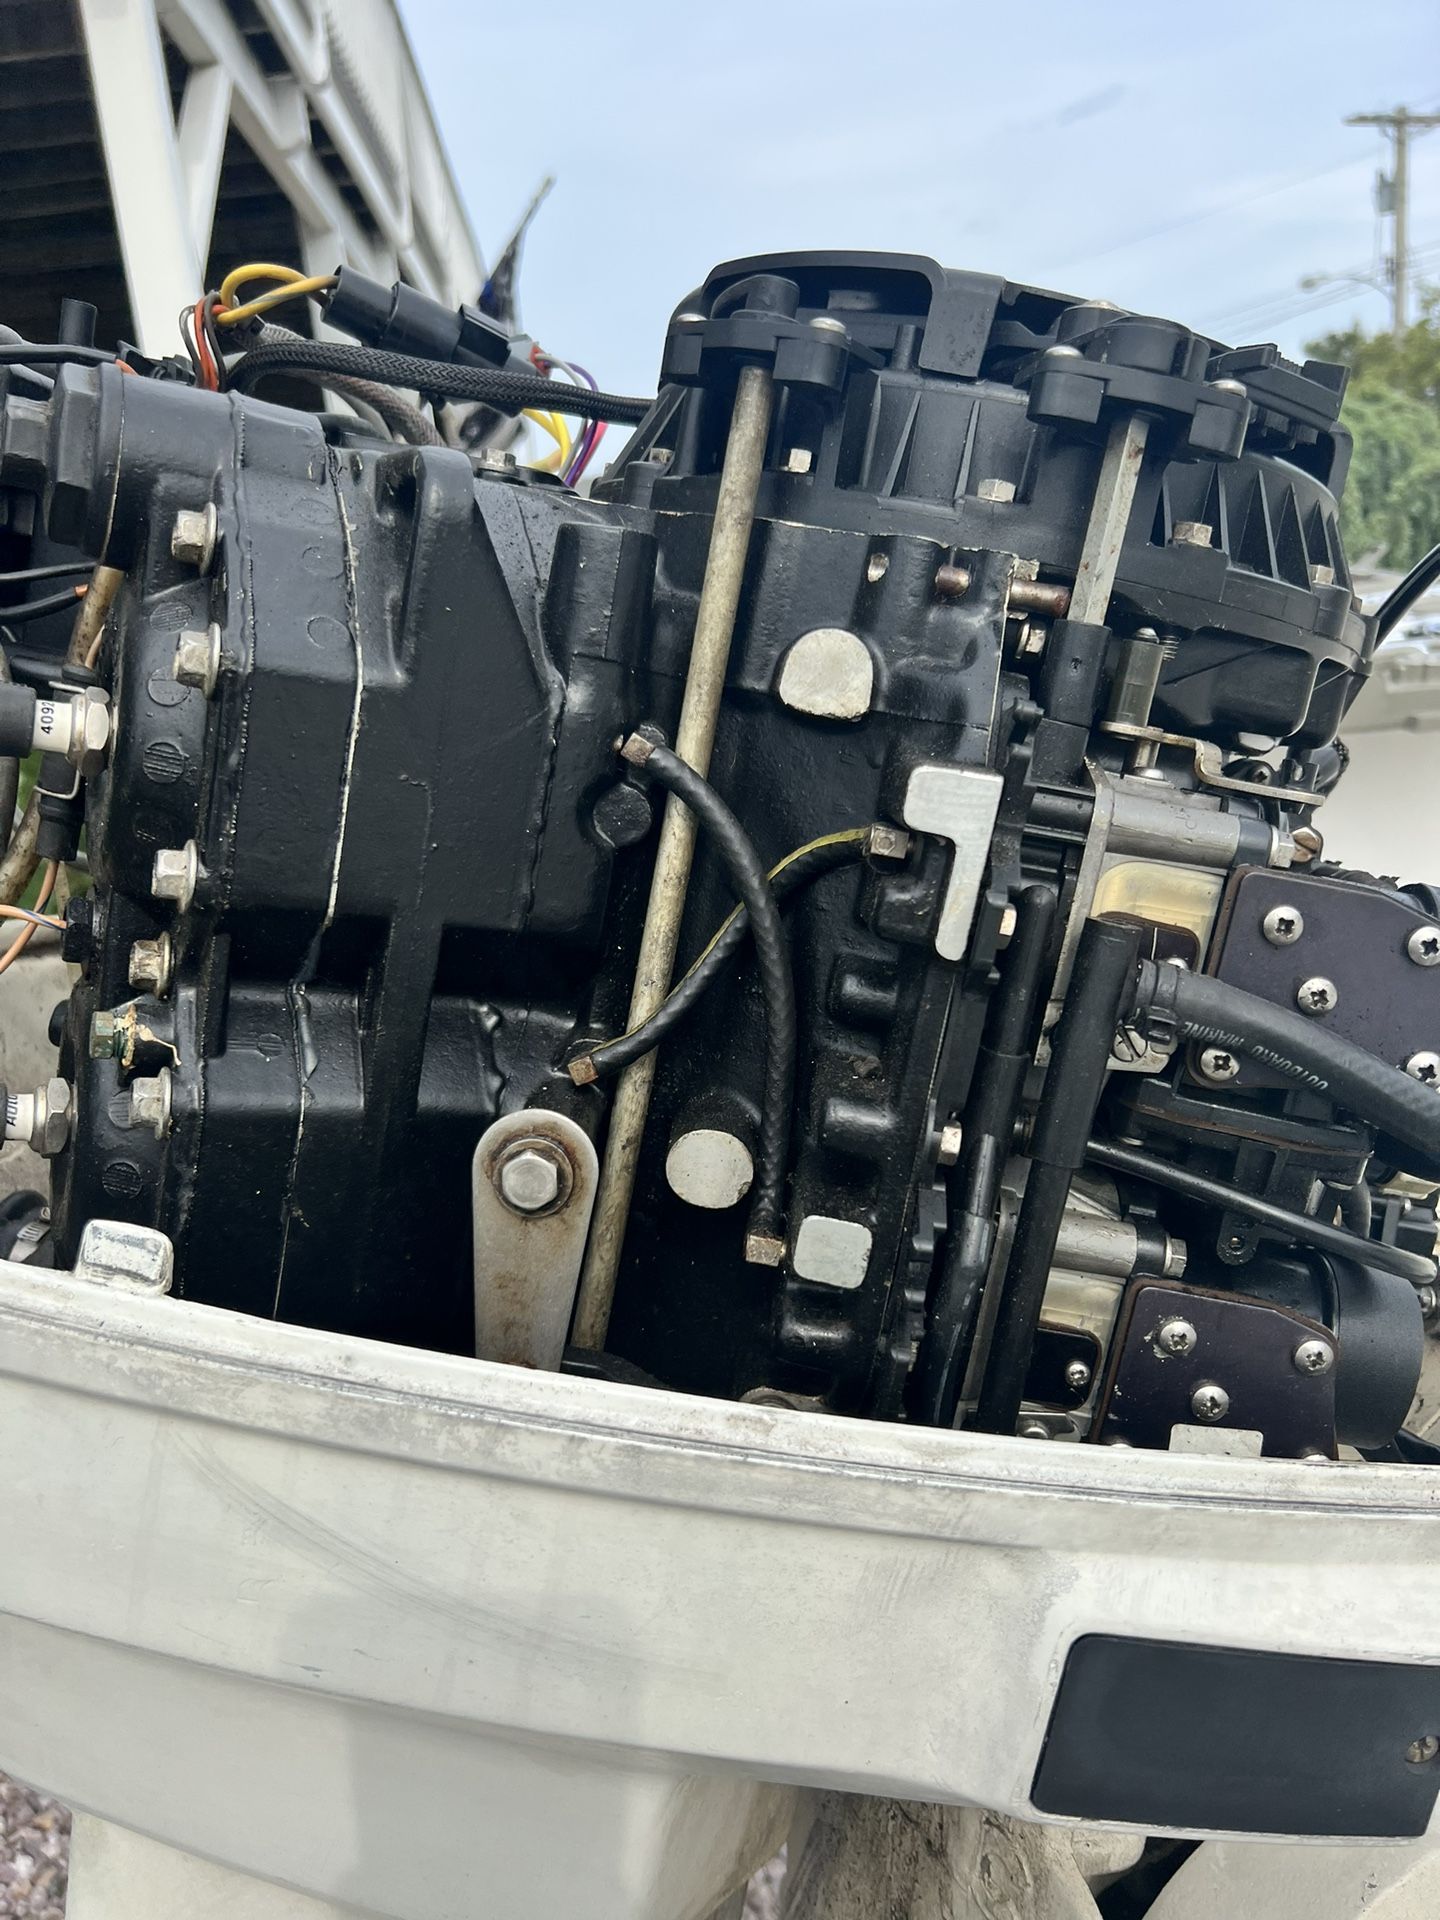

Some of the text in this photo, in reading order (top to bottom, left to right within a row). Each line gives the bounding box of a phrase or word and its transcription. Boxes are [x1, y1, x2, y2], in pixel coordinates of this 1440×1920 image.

[40, 701, 55, 734] 4092
[1183, 1020, 1329, 1090] OUTBOARD MARINE
